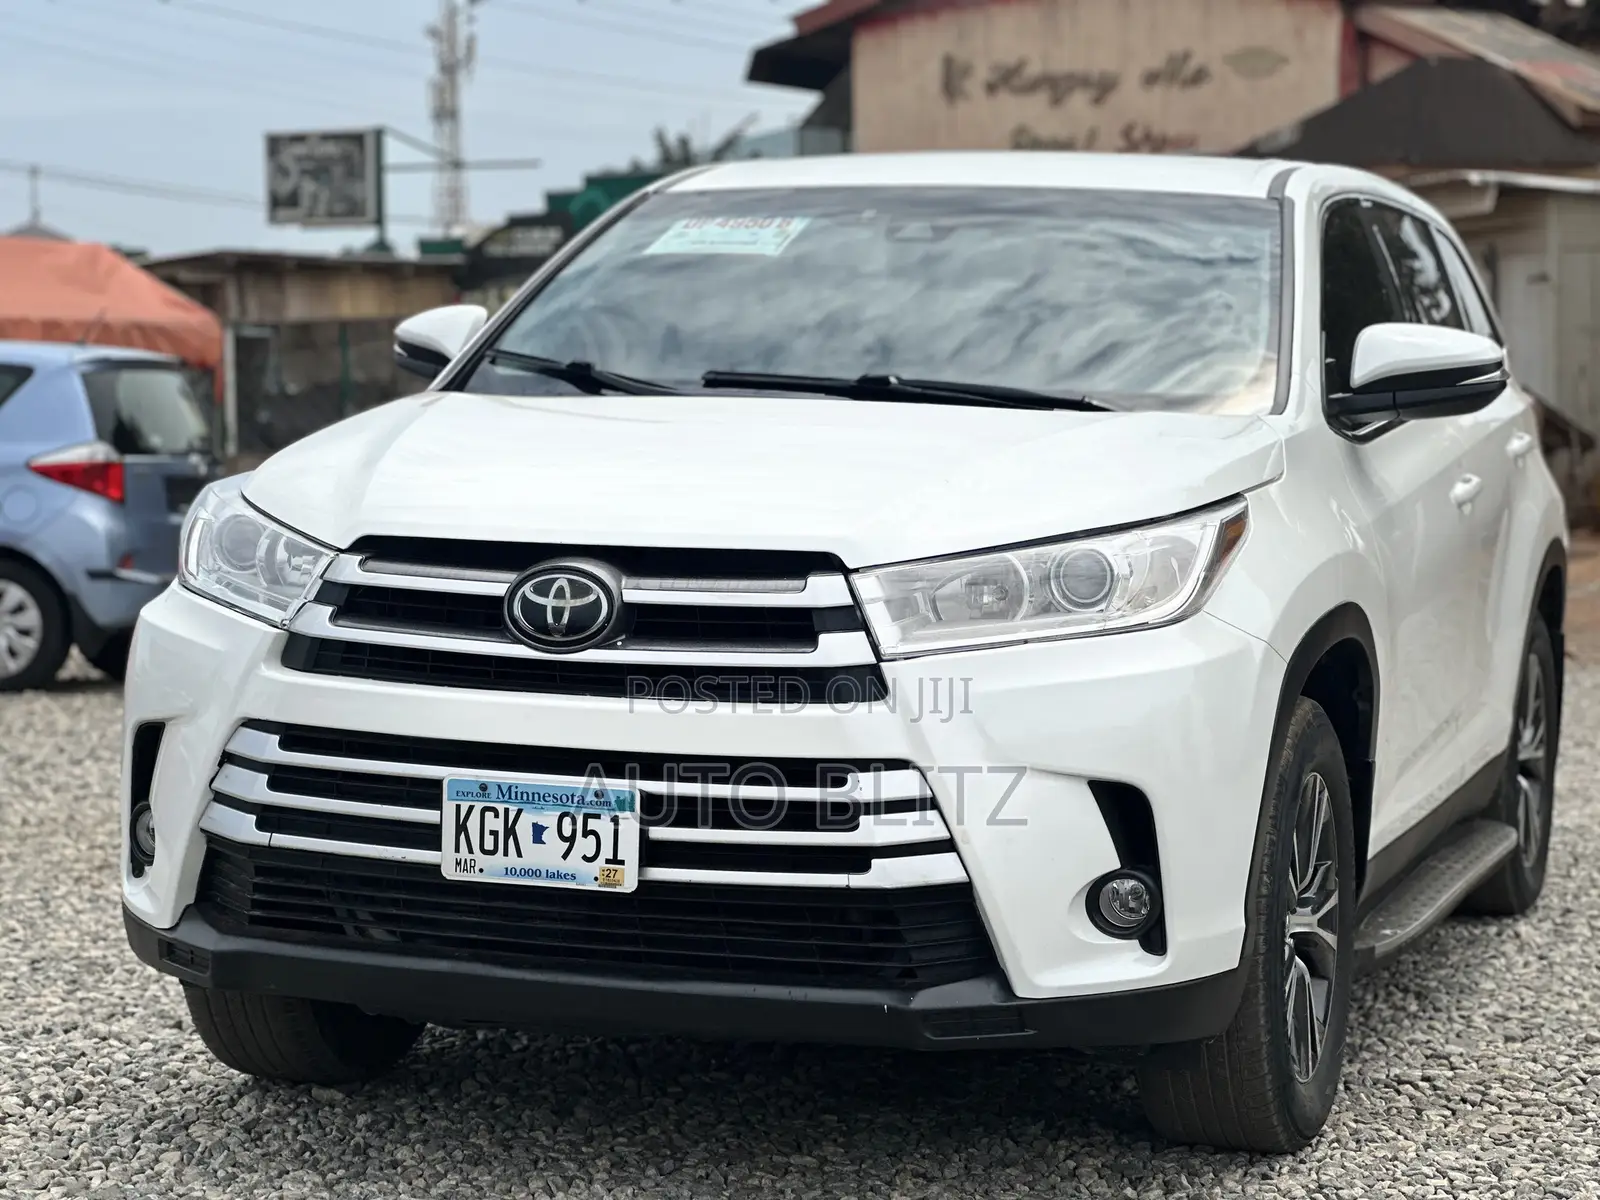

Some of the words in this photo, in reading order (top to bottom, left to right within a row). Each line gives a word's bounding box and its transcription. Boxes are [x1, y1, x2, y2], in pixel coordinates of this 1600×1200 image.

[456, 790, 492, 799] EXPLORE
[496, 784, 613, 808] Minnesota.com
[454, 804, 524, 858] KGK
[556, 811, 626, 866] 951
[454, 857, 477, 874] MAR
[504, 866, 542, 878] 10,000
[545, 869, 577, 880] lakes
[605, 868, 619, 879] 27
